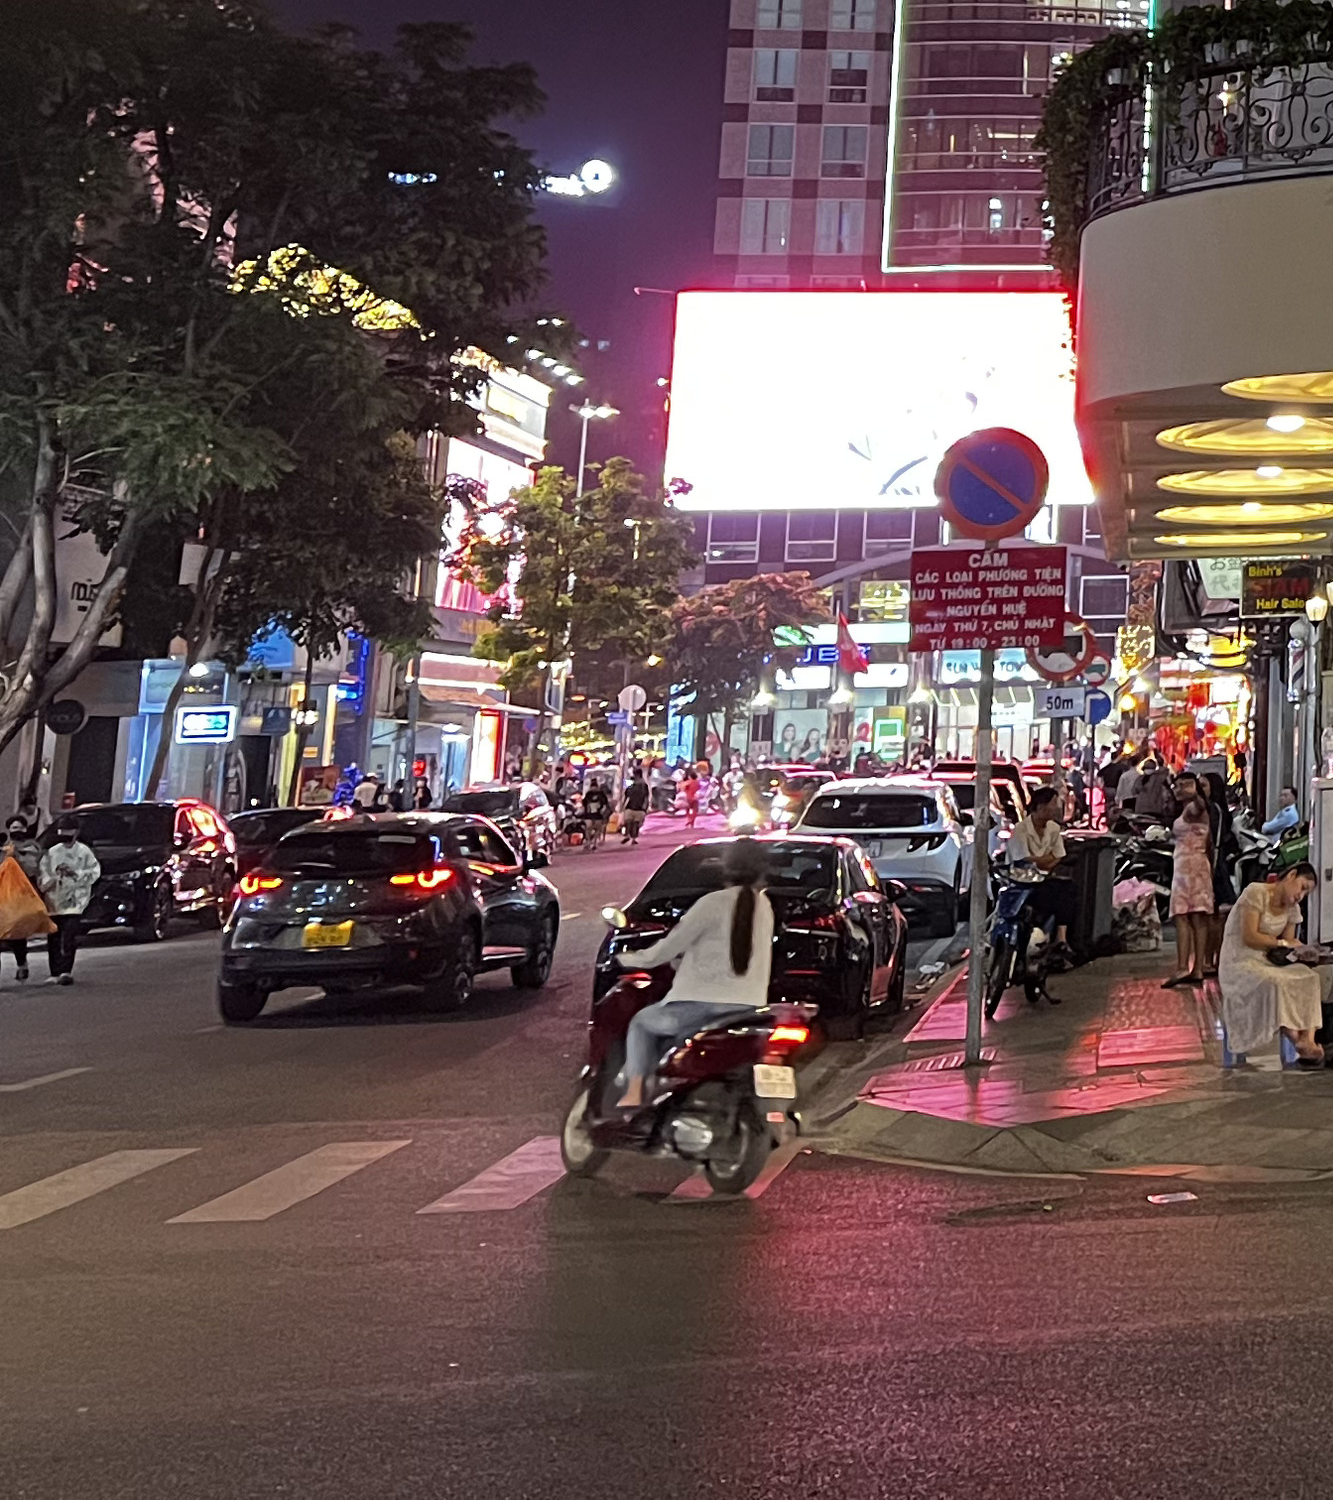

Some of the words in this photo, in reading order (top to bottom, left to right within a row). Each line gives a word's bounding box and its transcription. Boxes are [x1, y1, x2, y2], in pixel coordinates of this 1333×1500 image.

[968, 549, 1009, 568] CẤM
[915, 568, 939, 584] CÁC
[1281, 597, 1305, 609] Salo
[1046, 696, 1074, 710] 50m
